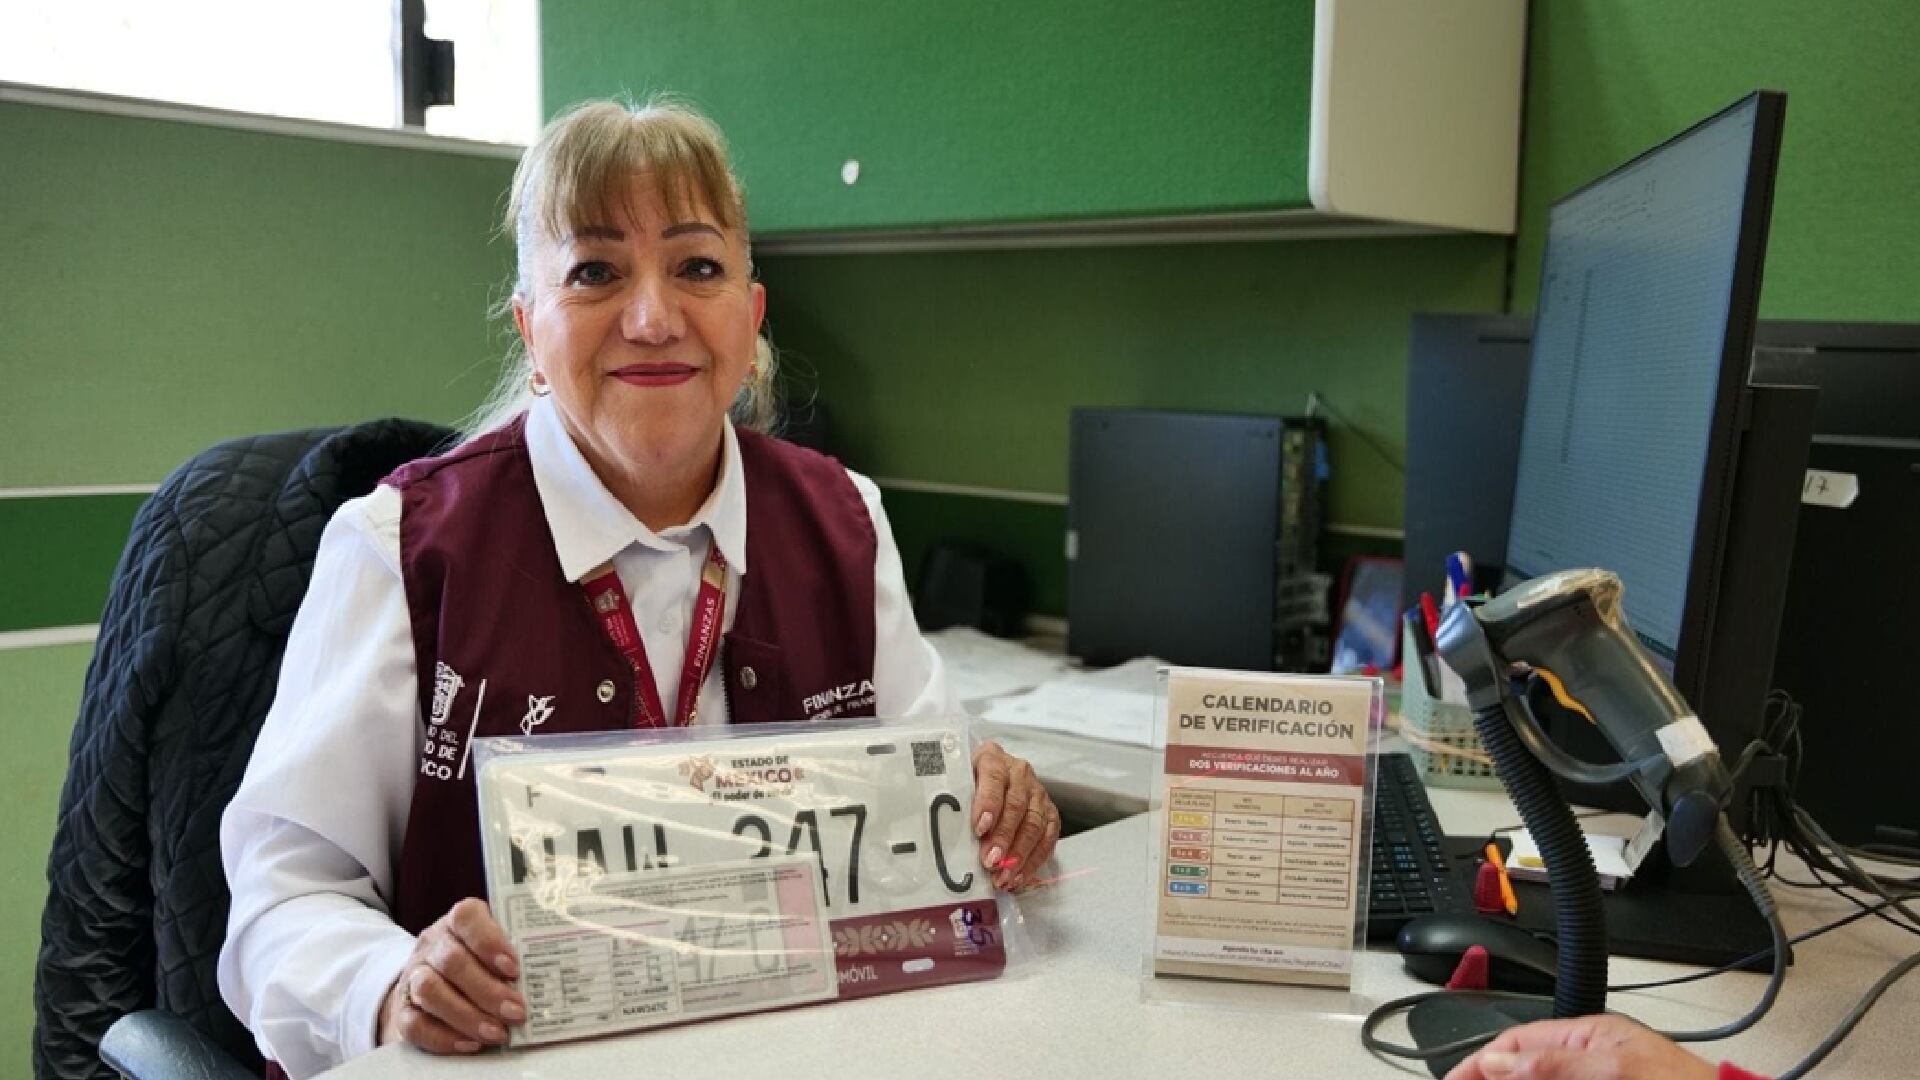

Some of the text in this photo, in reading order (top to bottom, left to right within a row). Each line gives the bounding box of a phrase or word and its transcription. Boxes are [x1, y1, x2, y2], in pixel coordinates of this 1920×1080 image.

[1202, 694, 1333, 716] CALENDARIO
[1180, 714, 1354, 740] DE VERIFICACIÓN
[731, 755, 789, 769] ESTADO DE
[1189, 759, 1339, 779] DOS VERIFICACIONES AL AÑO
